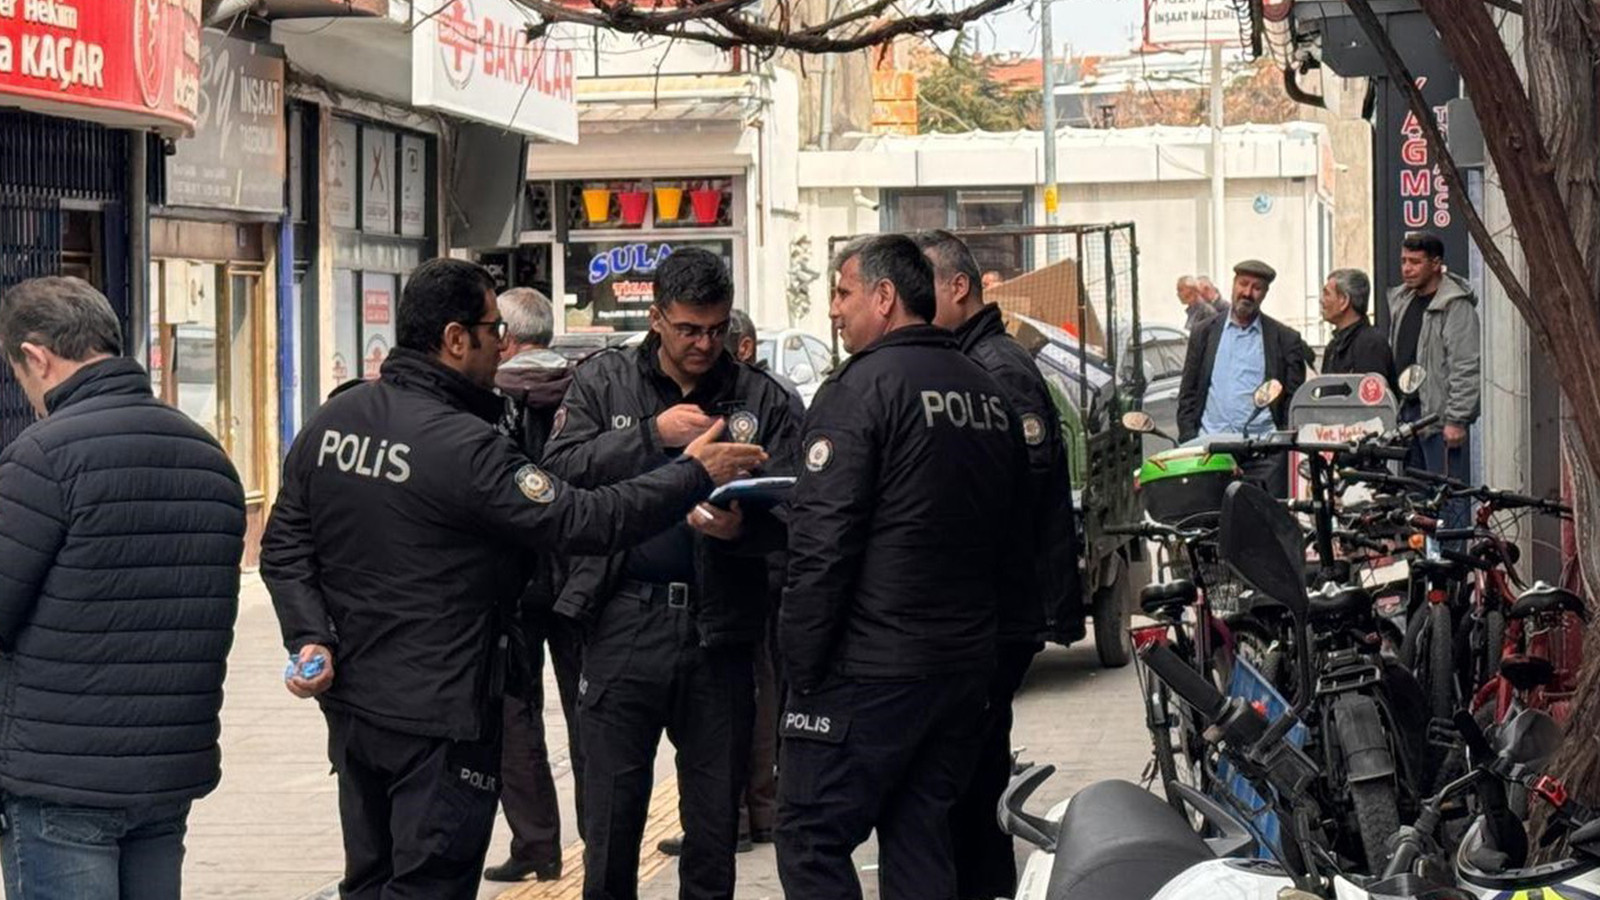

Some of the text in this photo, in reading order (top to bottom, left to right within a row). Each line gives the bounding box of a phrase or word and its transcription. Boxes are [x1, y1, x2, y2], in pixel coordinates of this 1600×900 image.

[24, 0, 78, 30] Hekim
[21, 34, 104, 90] KAÇAR
[240, 66, 280, 122] İNŞAAT
